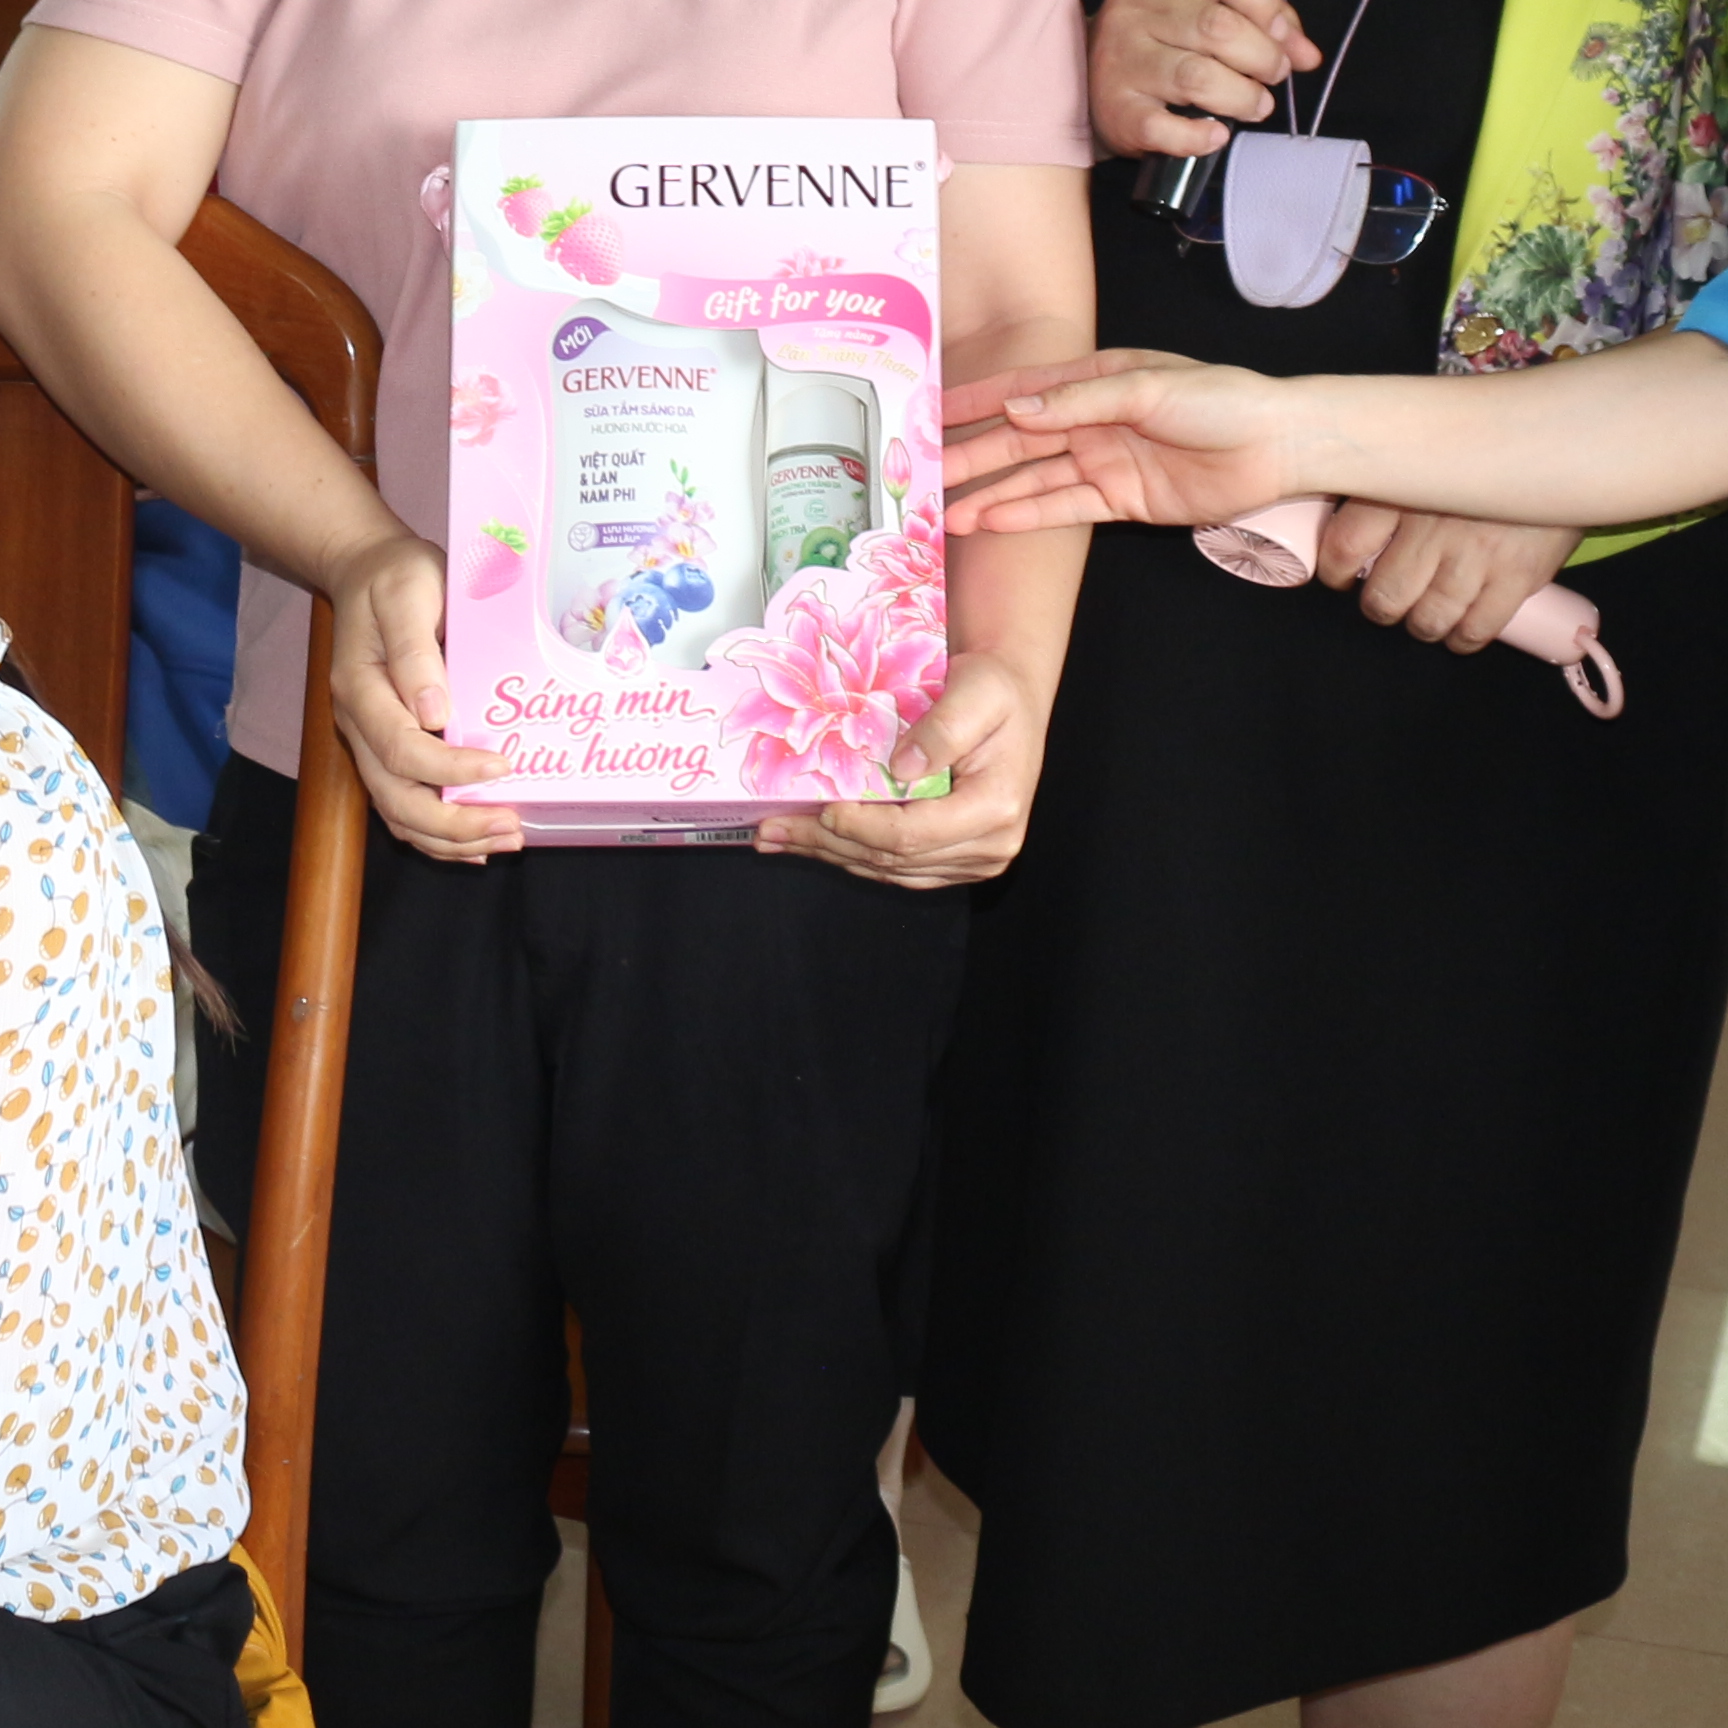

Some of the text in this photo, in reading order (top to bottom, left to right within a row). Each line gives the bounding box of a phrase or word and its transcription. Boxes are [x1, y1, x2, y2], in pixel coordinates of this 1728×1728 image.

[703, 283, 886, 322] Gift for you
[559, 324, 594, 355] MỚI
[677, 405, 694, 417] DA
[665, 422, 688, 434] HOA
[579, 448, 646, 469] VIỆT QUẤT
[580, 470, 618, 486] & LAN
[580, 487, 636, 504] NAM PHI
[485, 675, 716, 736] Sáng mịn
[582, 732, 716, 791] hương
